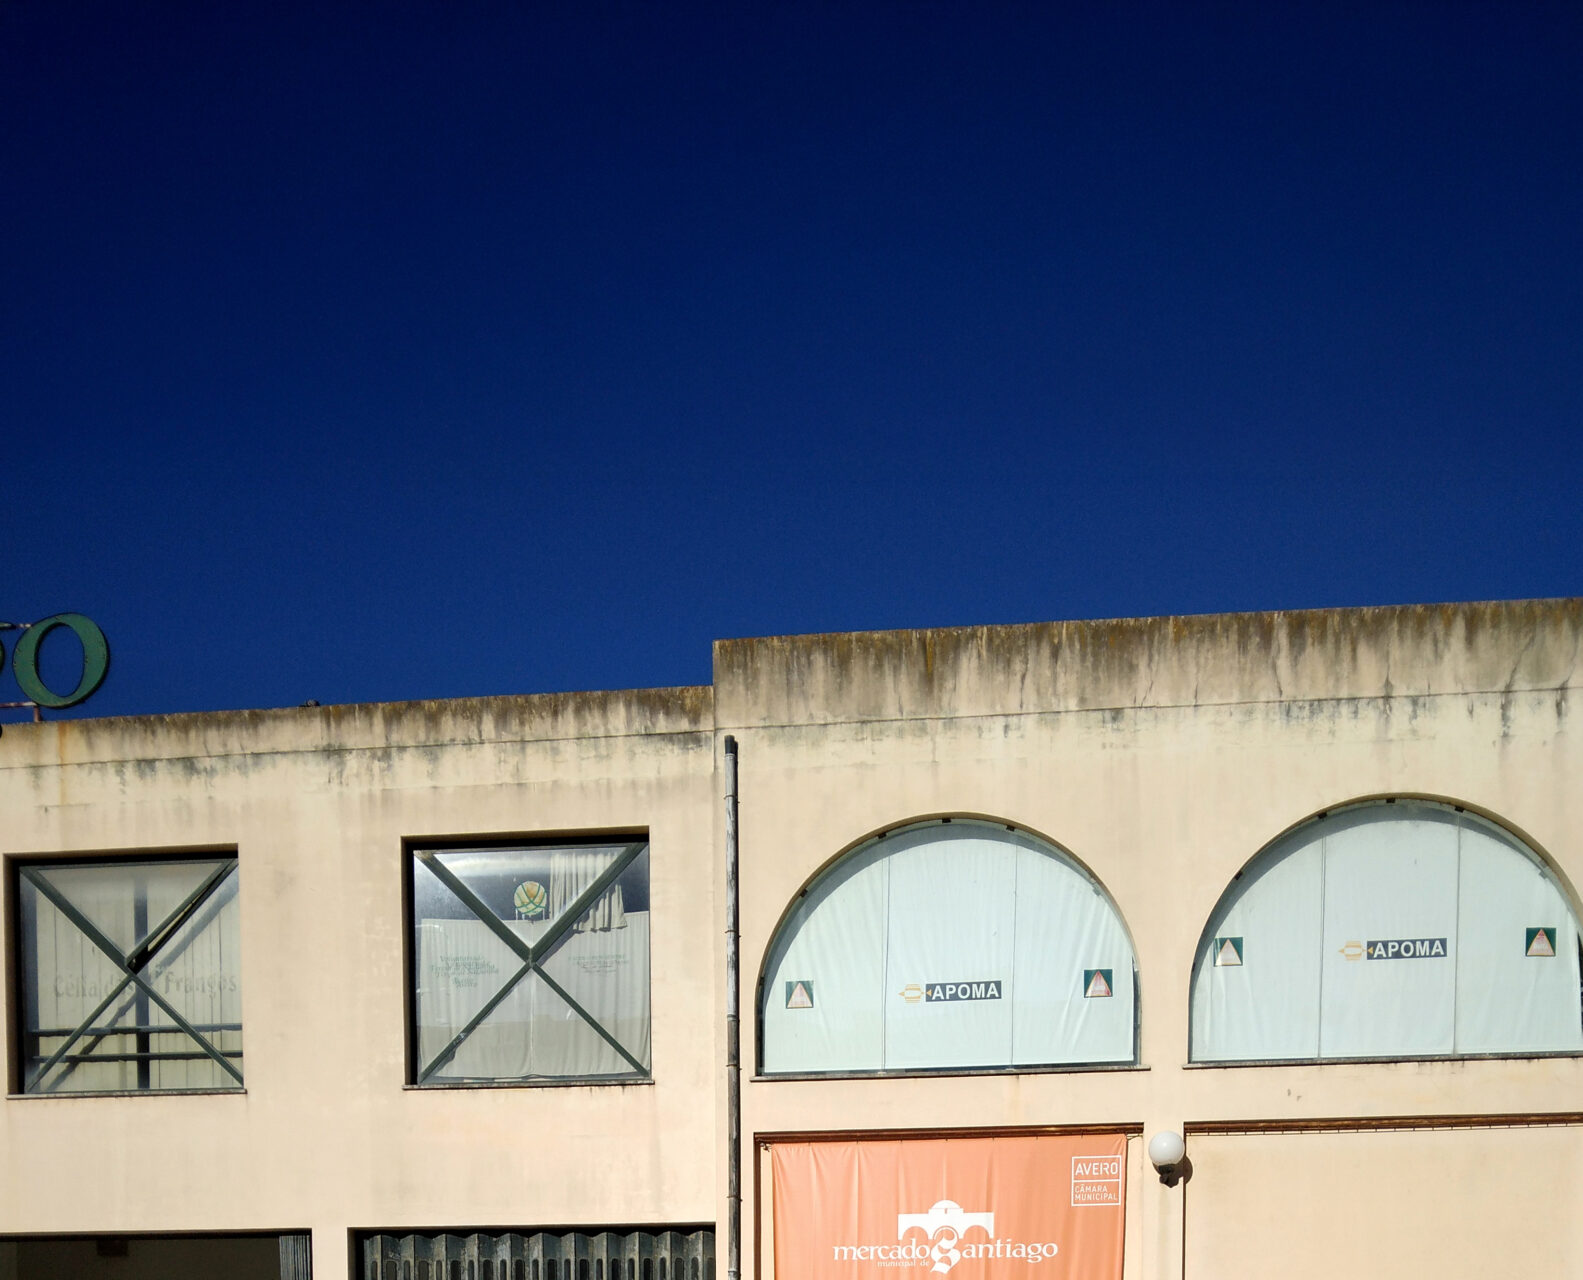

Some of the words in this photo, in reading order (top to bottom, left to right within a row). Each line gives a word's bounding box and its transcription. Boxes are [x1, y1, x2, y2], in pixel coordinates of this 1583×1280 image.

[1373, 940, 1445, 958] APOMA
[932, 982, 1000, 1000] APOMA
[1075, 1162, 1119, 1176] AVEIRO
[1074, 1192, 1118, 1201] MUNICIPAL
[832, 1238, 931, 1261] mercado
